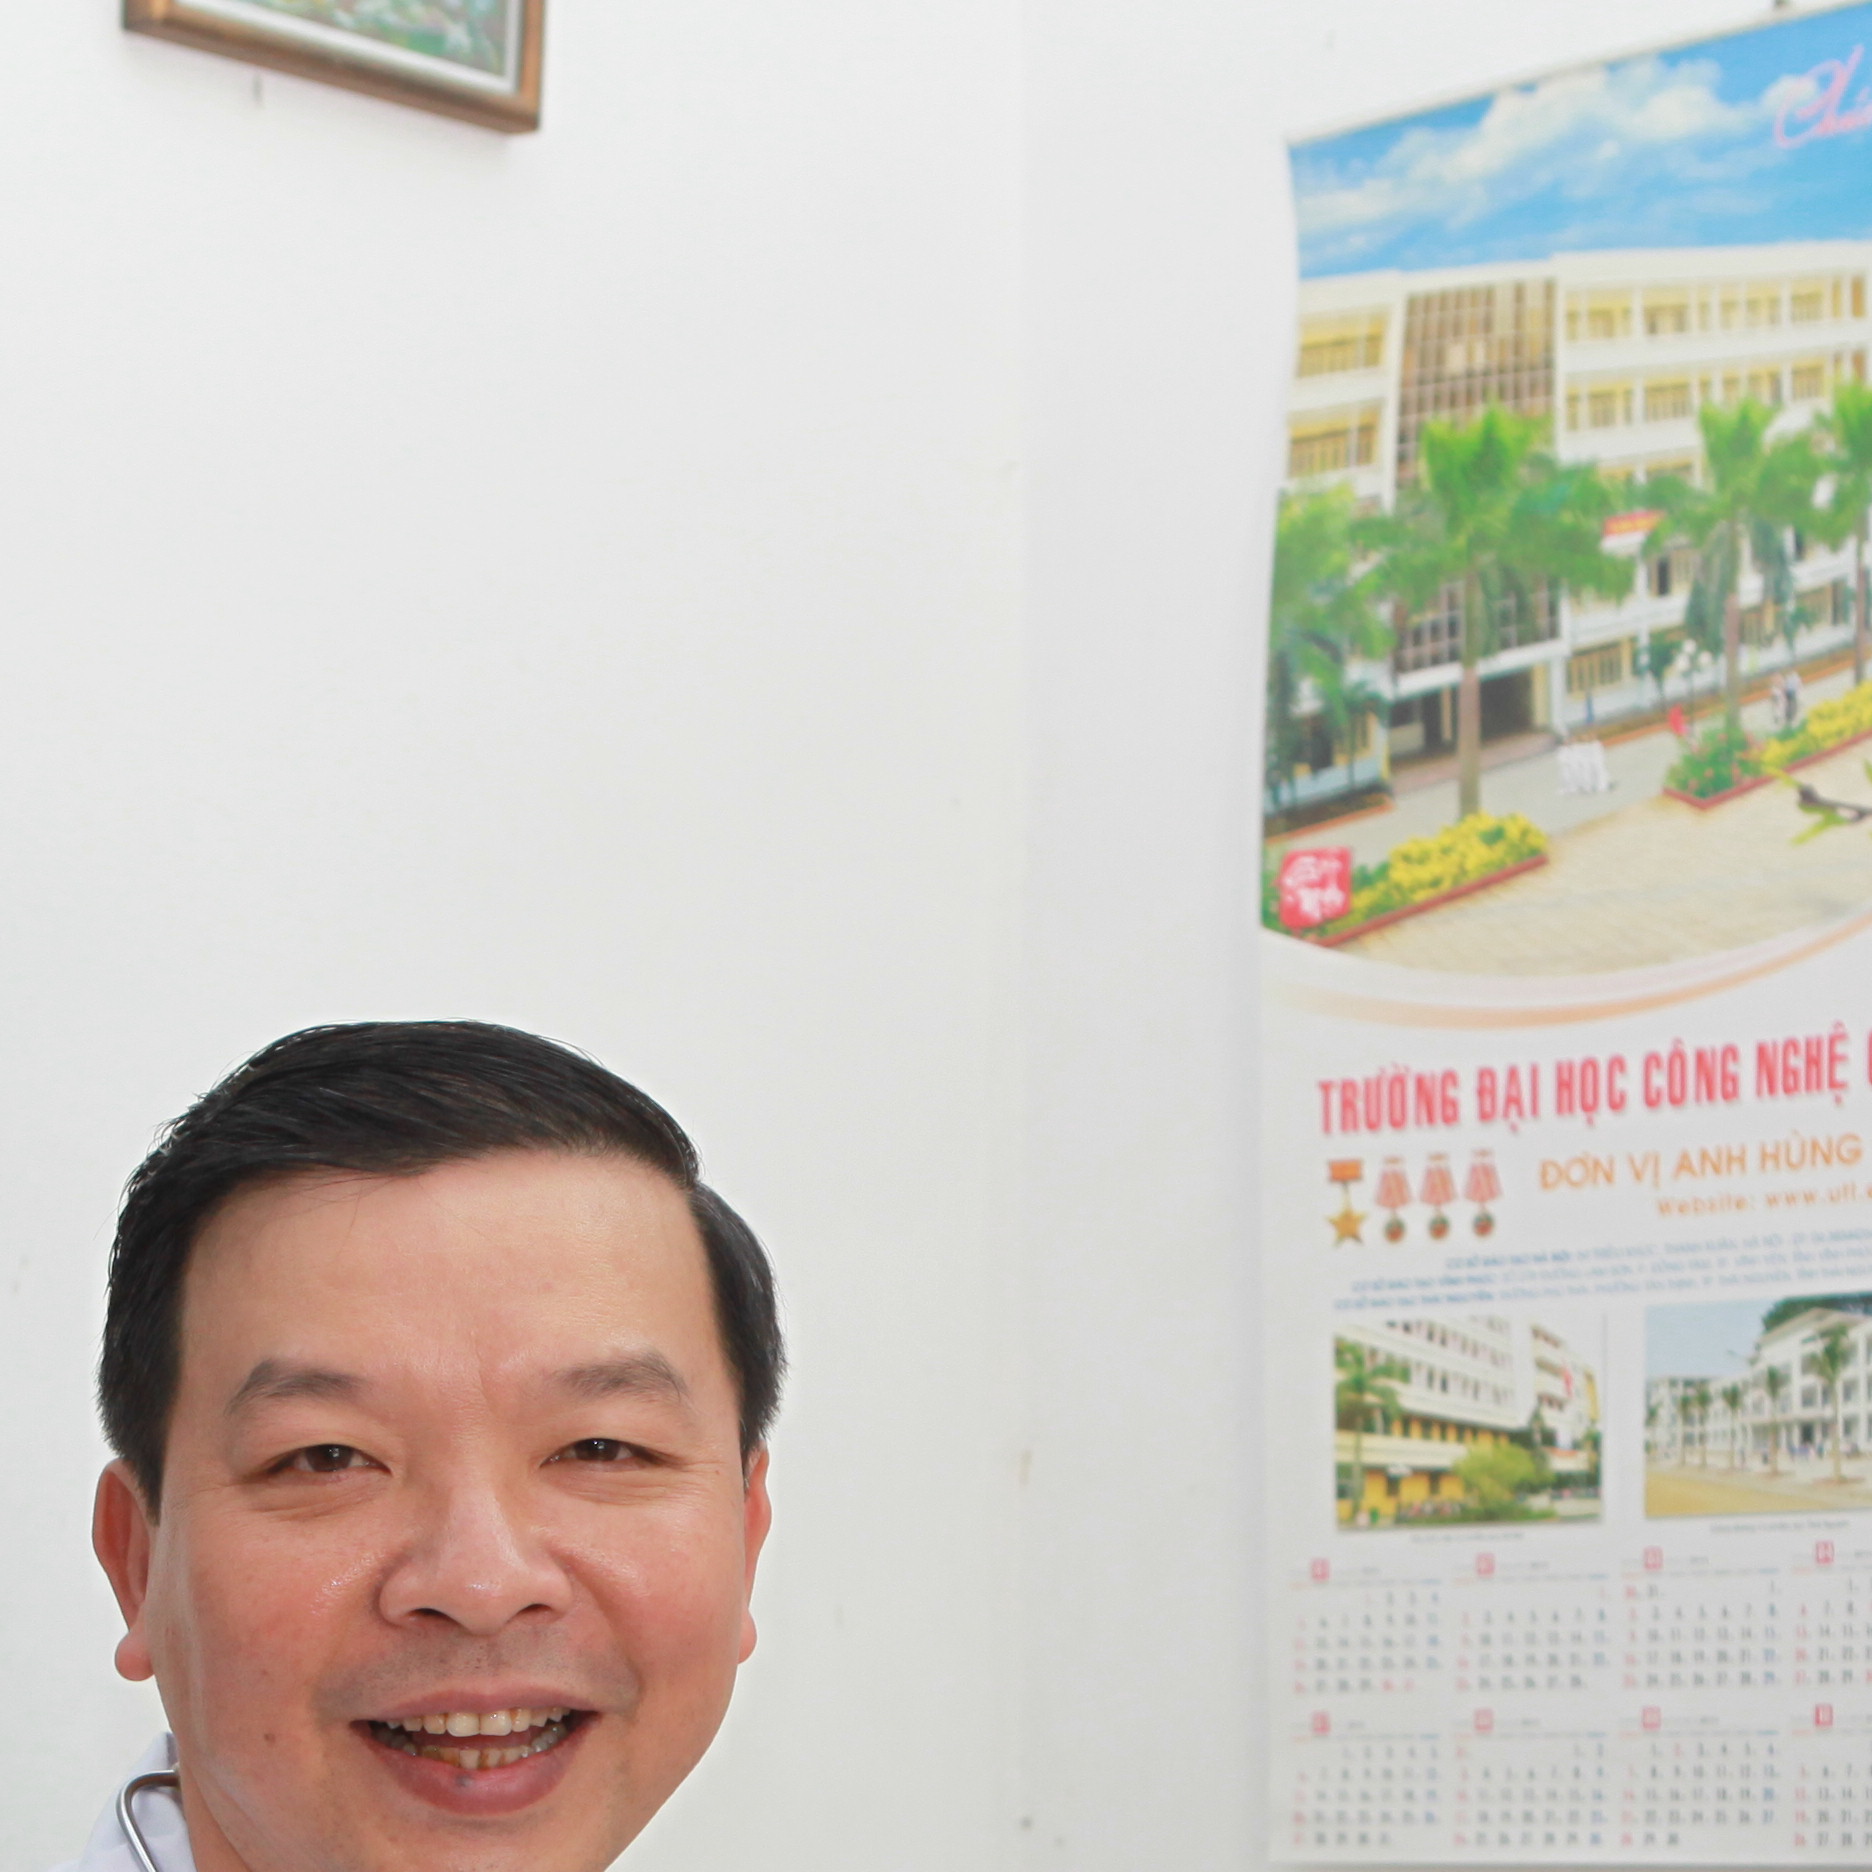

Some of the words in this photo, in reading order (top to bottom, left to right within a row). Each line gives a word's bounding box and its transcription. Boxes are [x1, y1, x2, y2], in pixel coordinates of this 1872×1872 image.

[1318, 1062, 1459, 1135] TRƯỜNG
[1476, 1062, 1540, 1134] ĐẠI
[1556, 1055, 1628, 1127] HỌC
[1644, 1038, 1740, 1110] CÔNG
[1755, 1021, 1848, 1105] NGHỆ
[1540, 1153, 1616, 1192] ĐƠN
[1628, 1151, 1662, 1189] VỊ
[1674, 1144, 1747, 1181] ANH
[1760, 1129, 1862, 1174] HÙNG
